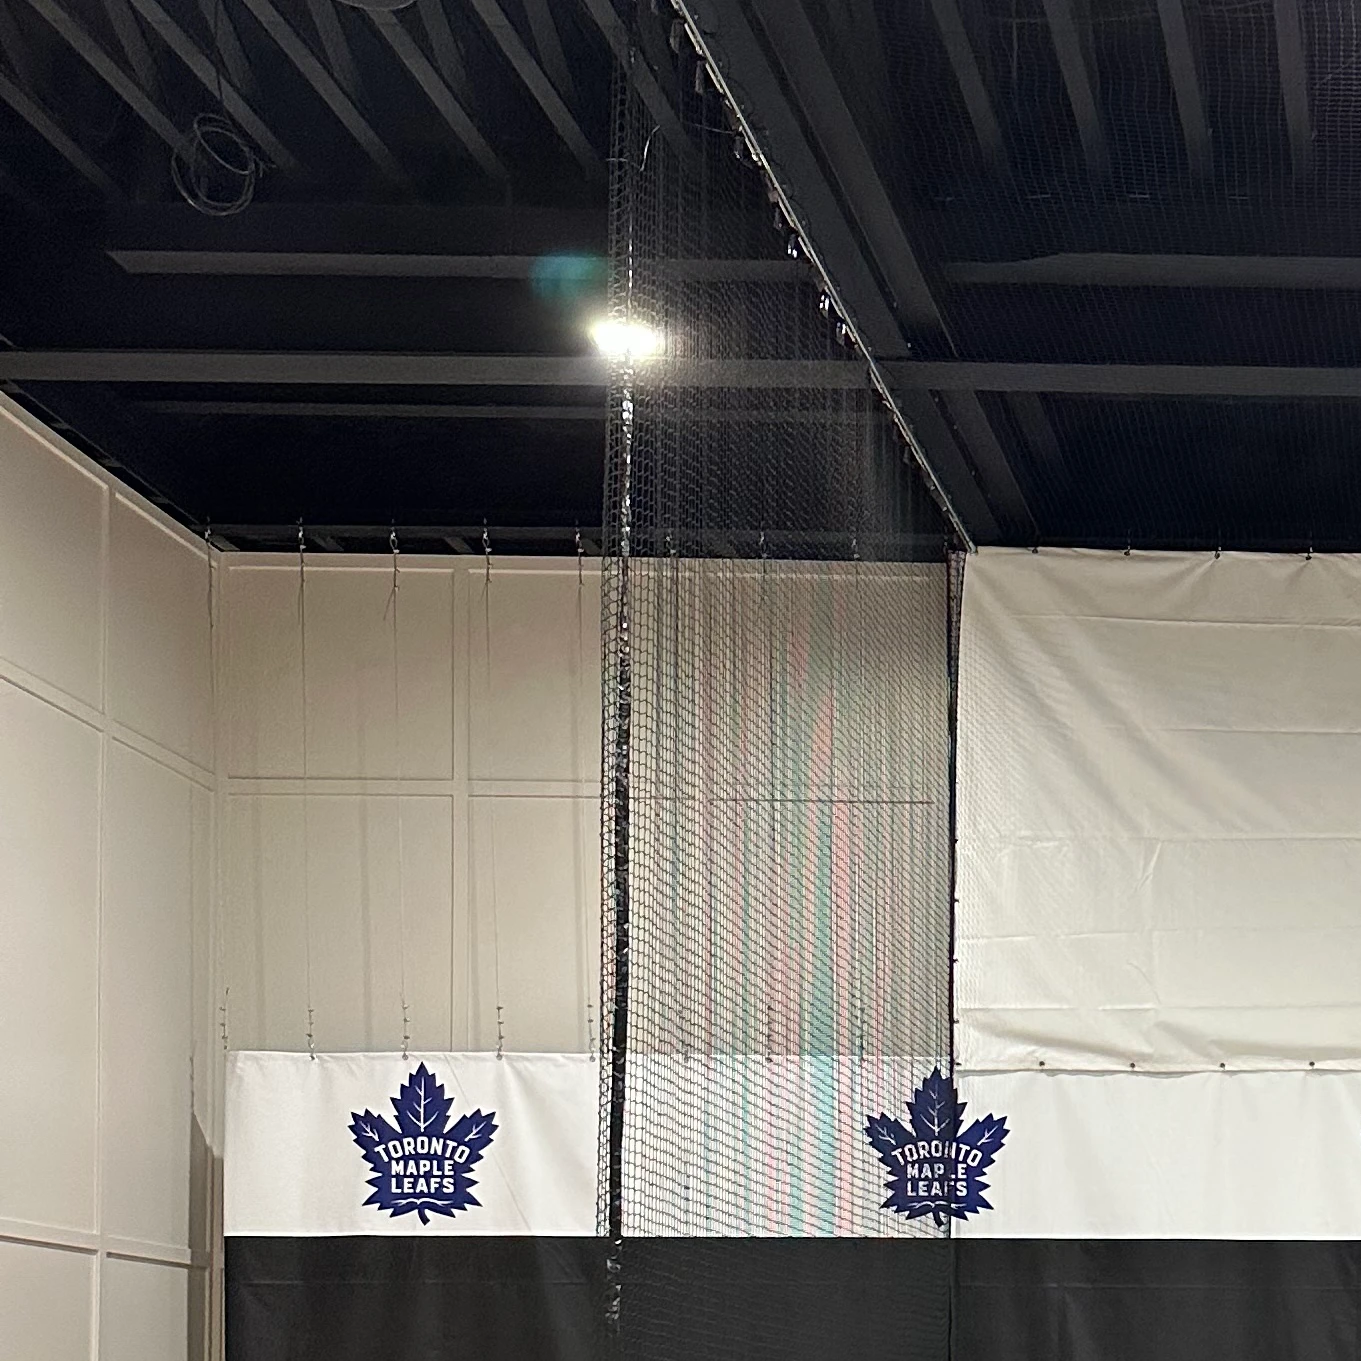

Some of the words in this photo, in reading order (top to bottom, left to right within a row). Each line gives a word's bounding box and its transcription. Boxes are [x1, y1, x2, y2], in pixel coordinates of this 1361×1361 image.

[374, 1136, 470, 1163] TORONTO
[391, 1160, 454, 1175] MAPLE
[391, 1178, 455, 1193] LEAFS
